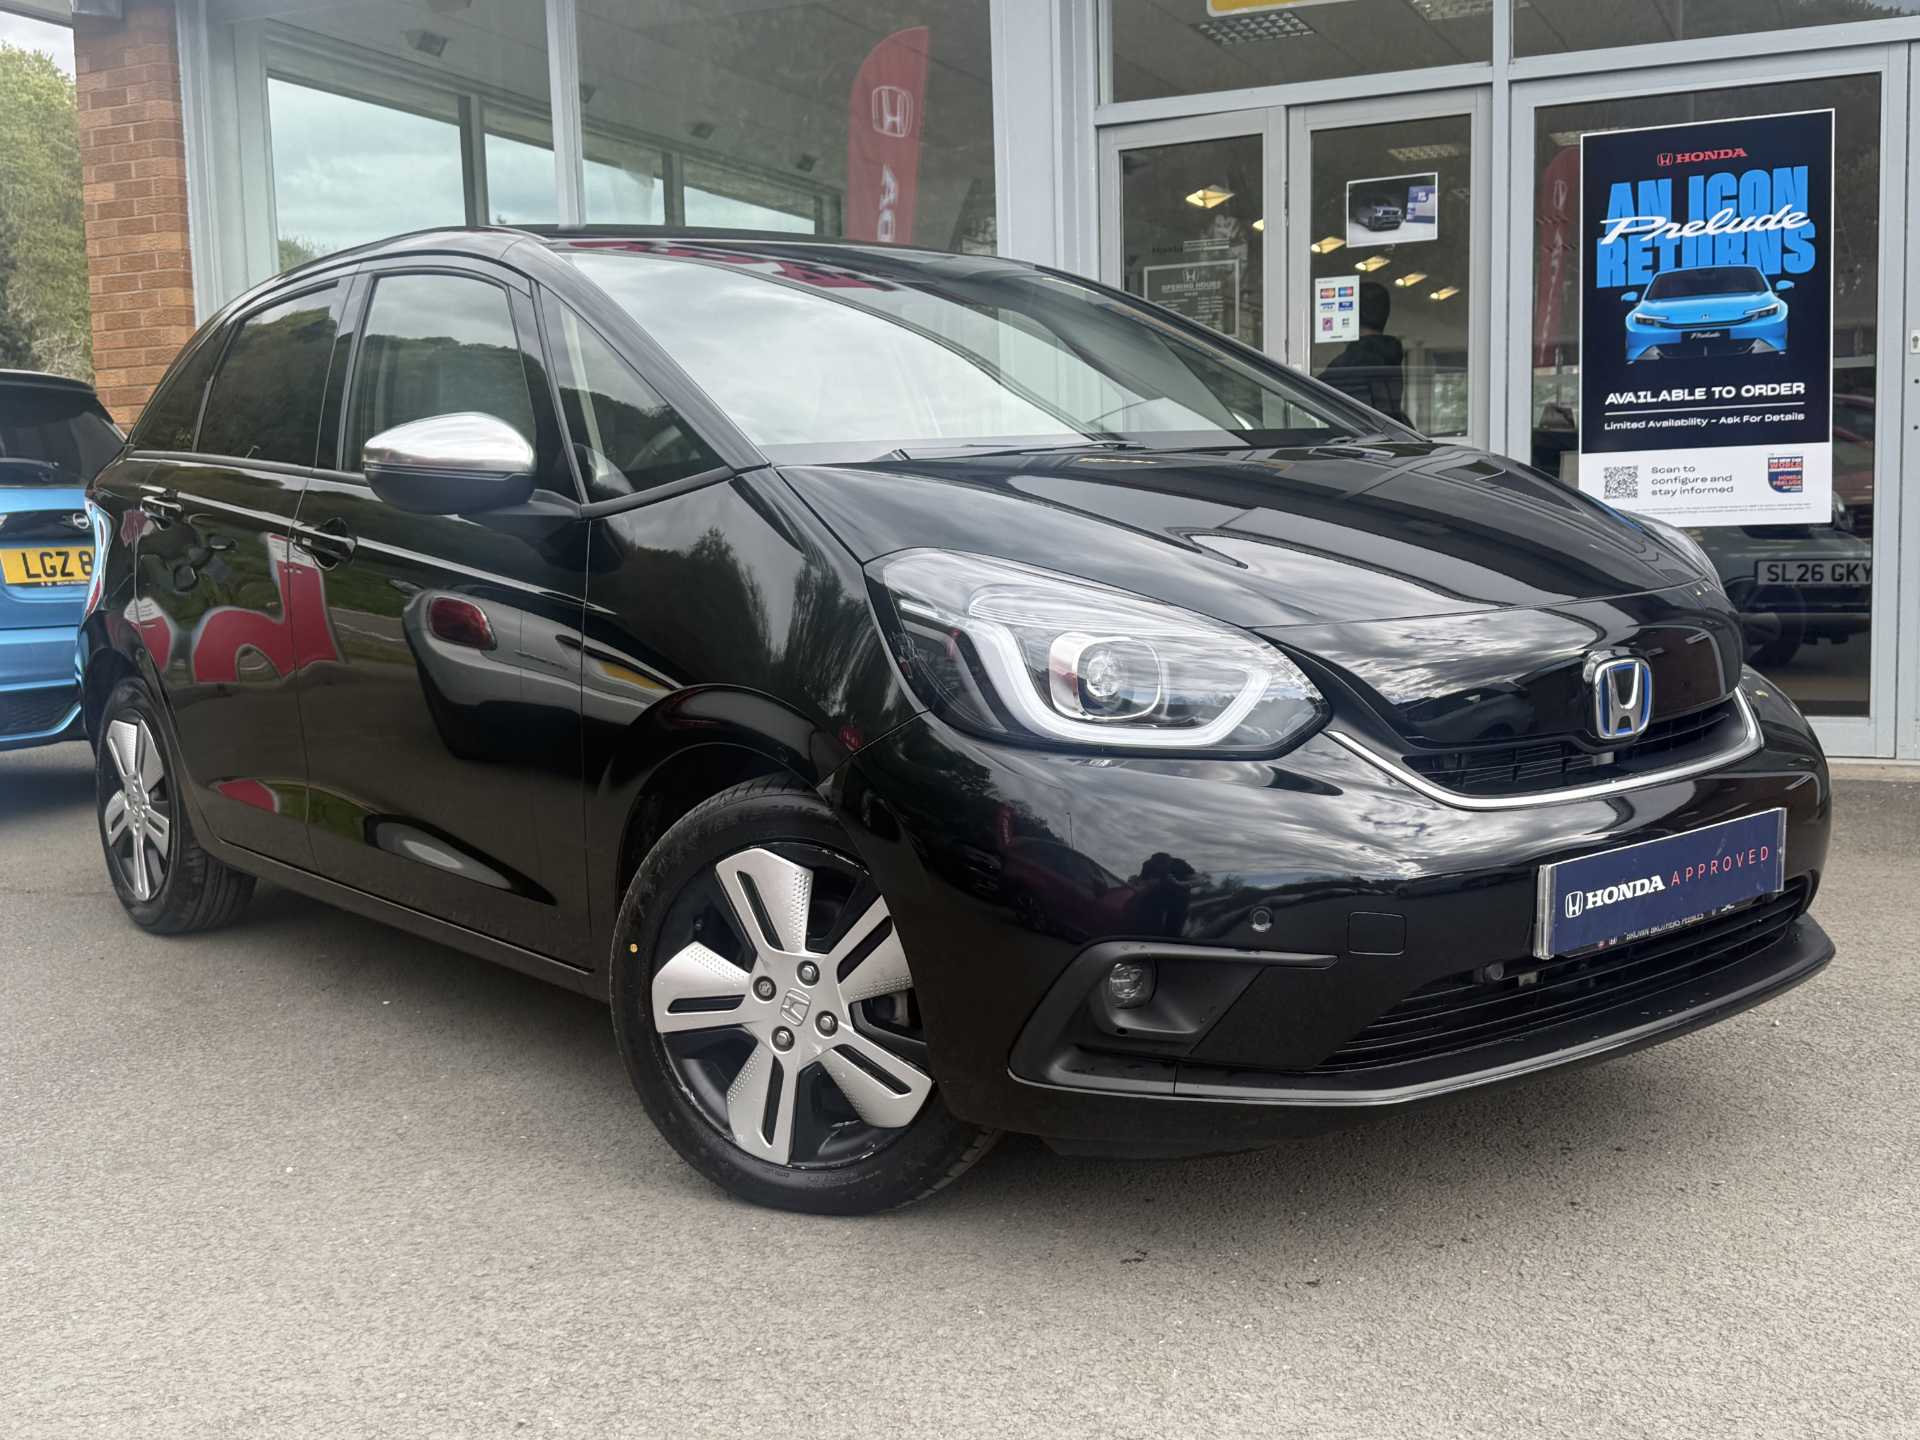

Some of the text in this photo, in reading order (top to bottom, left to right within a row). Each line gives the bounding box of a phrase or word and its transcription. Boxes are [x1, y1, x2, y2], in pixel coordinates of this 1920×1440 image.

[1675, 148, 1747, 164] HONDA
[1604, 165, 1809, 235] AN ICON
[1600, 204, 1811, 245] Prelude
[1596, 221, 1816, 288] RETURNS
[1604, 382, 1805, 406] AVAILABLE TO ORDER
[1604, 421, 1646, 431] Limited
[1647, 417, 1709, 429] Availability
[1719, 415, 1740, 424] Ask
[1743, 413, 1762, 423] For
[1765, 412, 1805, 422] Details
[1650, 464, 1696, 474] Scan to
[1651, 475, 1733, 486] configure and
[1651, 485, 1734, 497] stay informed
[21, 551, 74, 579] LGZ
[1767, 563, 1872, 582] SL26 GKY
[1585, 846, 1769, 909] HONDA APPROVED
